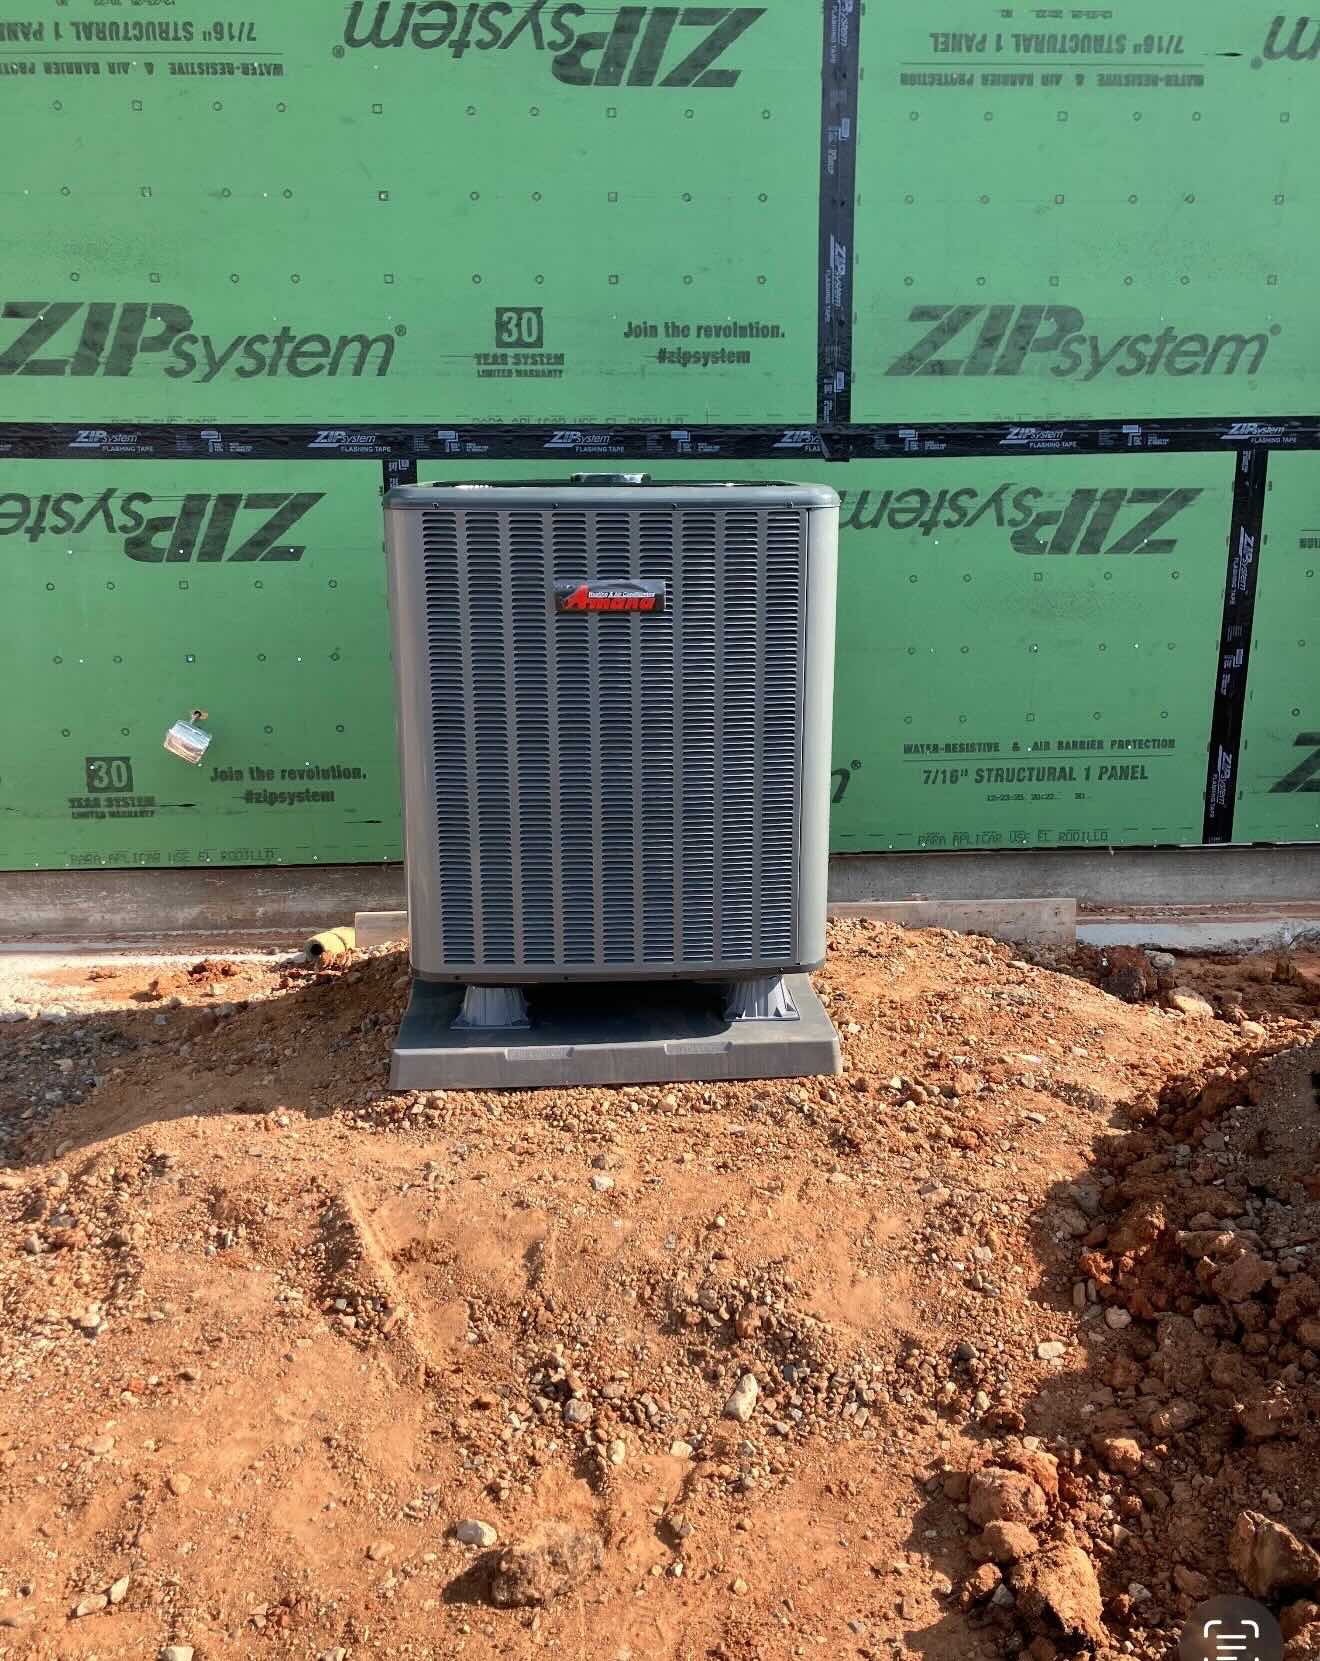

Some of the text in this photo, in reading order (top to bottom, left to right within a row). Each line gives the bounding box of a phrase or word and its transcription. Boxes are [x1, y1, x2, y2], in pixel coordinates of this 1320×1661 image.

[53, 21, 63, 41] 1
[70, 21, 194, 42] STRUCTURAL
[929, 32, 988, 54] PANEL
[995, 33, 1004, 53] 1
[1011, 33, 1127, 55] STRUCTURAL
[44, 61, 101, 76] BARRIER
[107, 61, 131, 75] AIR
[501, 310, 541, 345] 30
[623, 321, 786, 339] Join the revolution.
[655, 348, 752, 368] #zipsystem
[564, 583, 657, 609] Amana
[1031, 741, 1051, 751] AIR
[1057, 739, 1105, 751] BARRIER
[1110, 738, 1176, 750] PROTECTION
[92, 760, 129, 789] 30
[210, 765, 367, 782] Join the revolution.
[922, 764, 1149, 785] 7/16" STRUCTURAL 1 PANEL
